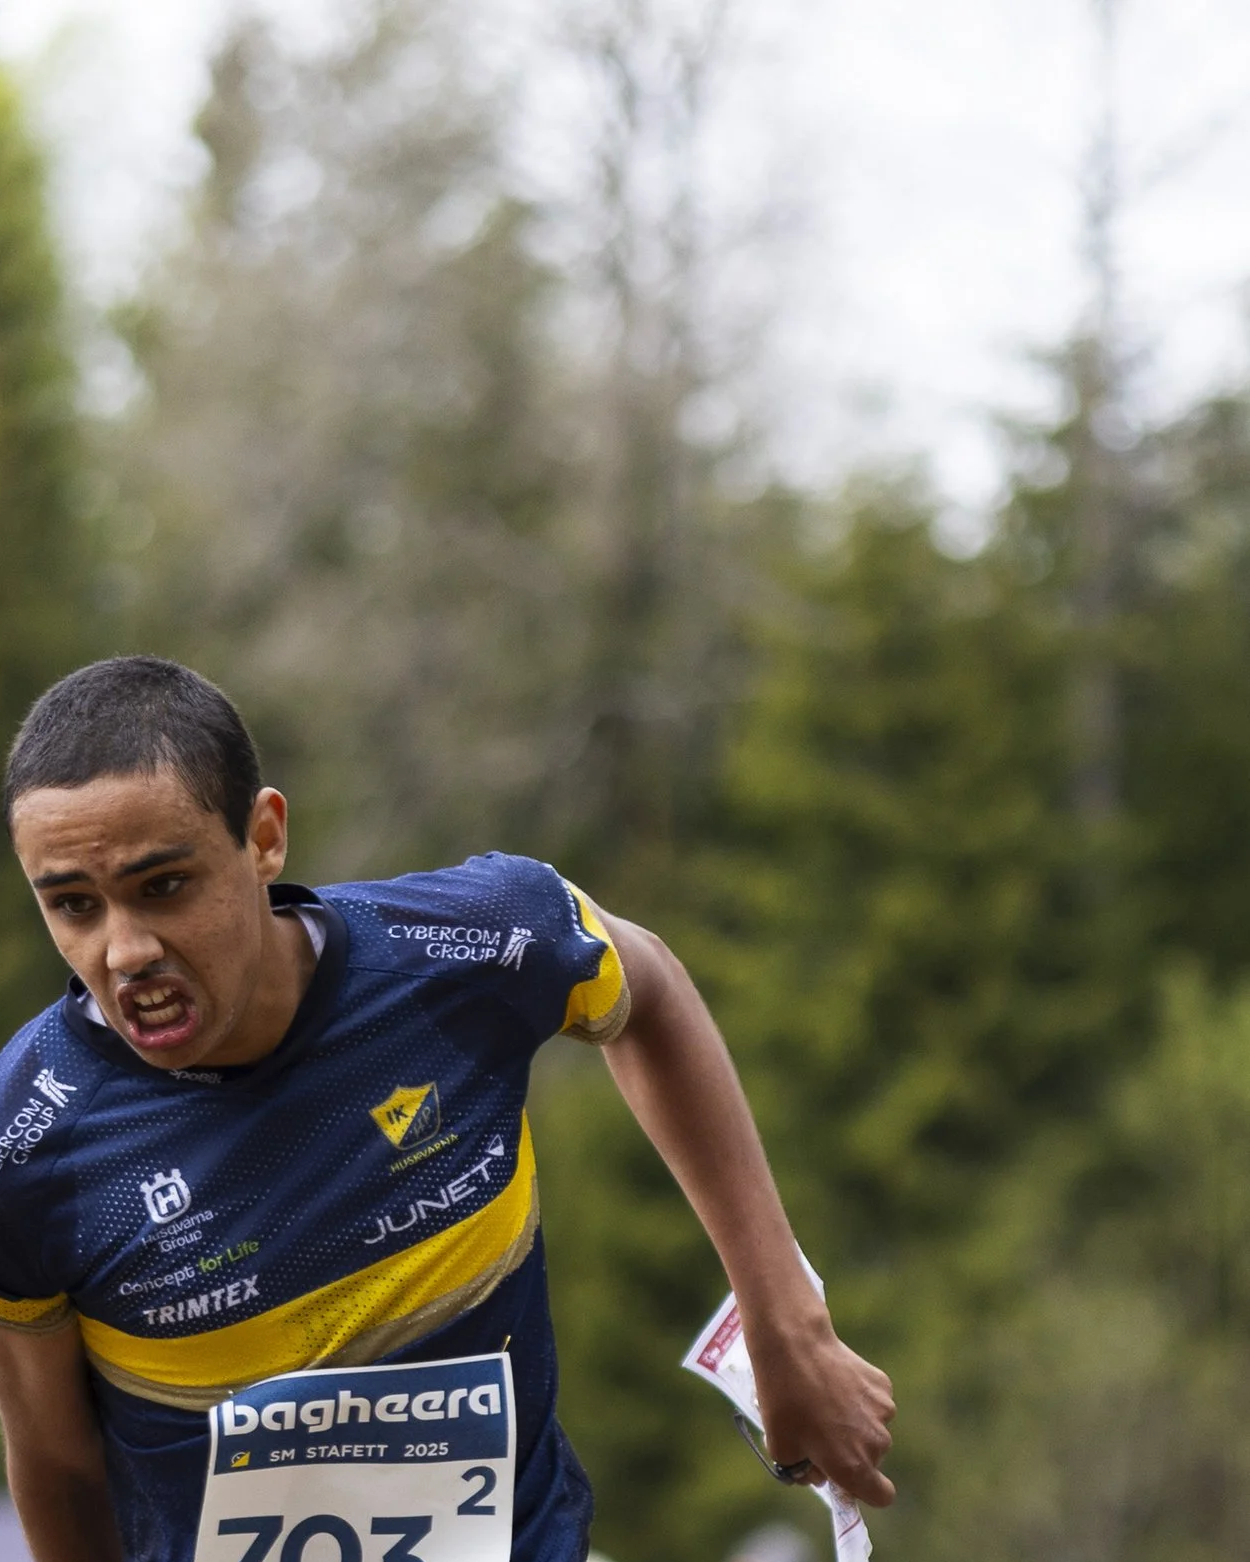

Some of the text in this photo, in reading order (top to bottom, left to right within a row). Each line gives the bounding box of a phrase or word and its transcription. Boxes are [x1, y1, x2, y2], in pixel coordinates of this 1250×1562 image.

[388, 924, 500, 946] CYBERCOM
[426, 943, 497, 962] GROUP
[386, 1104, 409, 1125] IK
[12, 1107, 56, 1165] GROUP
[390, 1133, 459, 1174] HUSKVARNA
[363, 1156, 493, 1245] JUNET
[141, 1209, 214, 1247] Husqvarna
[160, 1230, 203, 1253] Group
[119, 1240, 260, 1296] Concept for Life
[142, 1274, 260, 1325] TRIMTEX
[223, 1383, 502, 1437] bagheera
[269, 1442, 450, 1463] SM STAFETT 2025
[456, 1465, 497, 1517] 2
